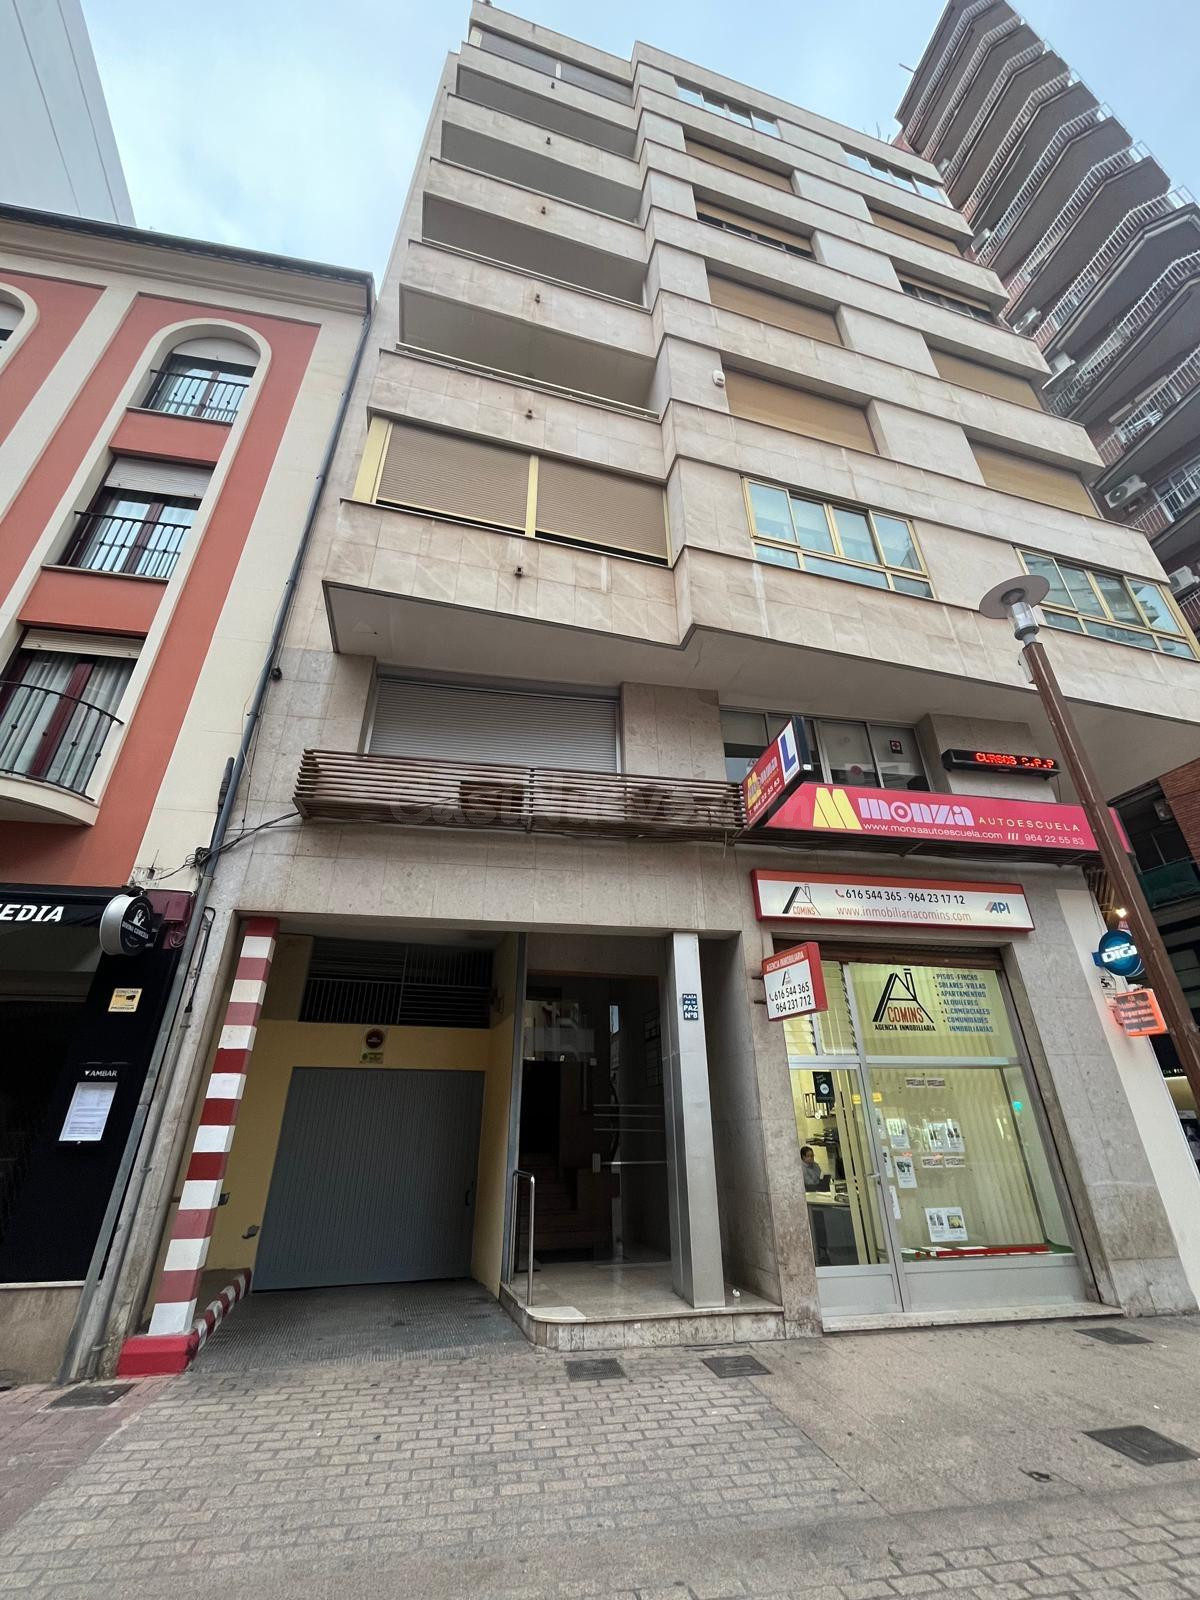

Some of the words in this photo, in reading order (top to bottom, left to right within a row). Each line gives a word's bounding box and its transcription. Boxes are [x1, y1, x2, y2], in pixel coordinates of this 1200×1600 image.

[779, 733, 797, 772] L
[976, 752, 1017, 766] CURSOS
[978, 816, 1081, 832] AUTOESCUELA
[863, 823, 1003, 840] www.monzaautoescuela.com
[1024, 833, 1043, 843] 964
[1044, 835, 1057, 843] 22
[1058, 835, 1071, 844] 55
[1072, 836, 1085, 846] 83
[845, 889, 864, 900] 616
[865, 889, 882, 901] 544
[885, 890, 902, 902] 365
[908, 892, 926, 903] 964
[928, 893, 939, 903] 23
[940, 894, 952, 904] 17
[954, 895, 966, 905] 12
[0, 904, 64, 922] EDIA
[793, 906, 816, 916] COMINS
[836, 905, 972, 922] www.inmobiliariacomins.com
[990, 901, 1011, 914] API
[1101, 944, 1138, 963] DIGI
[774, 988, 786, 1001] 616
[785, 985, 797, 998] 544
[797, 982, 810, 994] 365
[940, 990, 987, 998] APARTAMENTOS
[775, 1002, 787, 1013] 964
[787, 998, 799, 1011] 231
[799, 995, 812, 1008] 712
[886, 1006, 924, 1024] COMINS
[874, 1023, 898, 1031] AGENCIA
[899, 1024, 936, 1032] INMOBILIARIA
